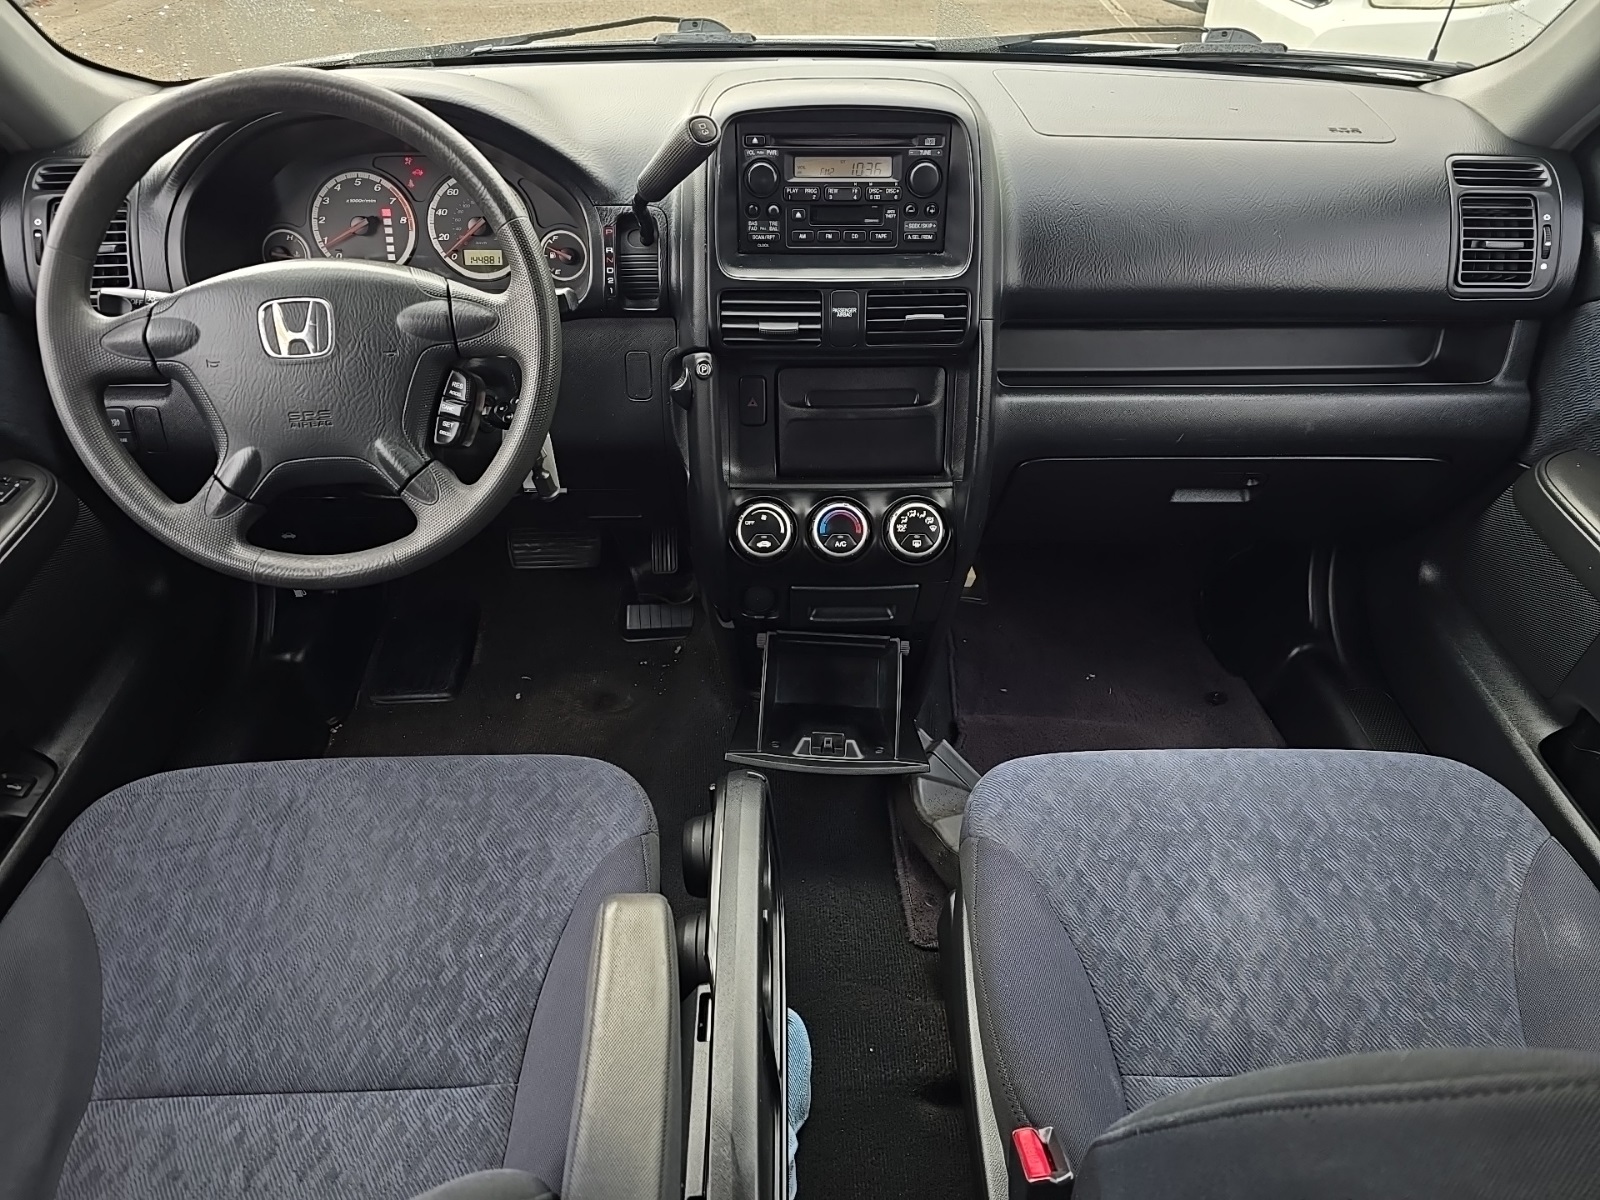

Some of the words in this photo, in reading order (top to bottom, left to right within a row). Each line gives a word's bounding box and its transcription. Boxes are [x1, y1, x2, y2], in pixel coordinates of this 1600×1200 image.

[353, 178, 362, 187] 5
[333, 183, 342, 192] 4
[373, 183, 382, 192] 6
[446, 188, 459, 196] 60
[322, 197, 330, 205] 3
[389, 197, 397, 205] 7
[435, 208, 448, 216] 40
[318, 216, 326, 224] 2
[399, 216, 408, 224] 8
[438, 233, 450, 241] 20
[451, 381, 464, 390] RES
[442, 420, 455, 428] SET
[834, 540, 848, 548] A/C
